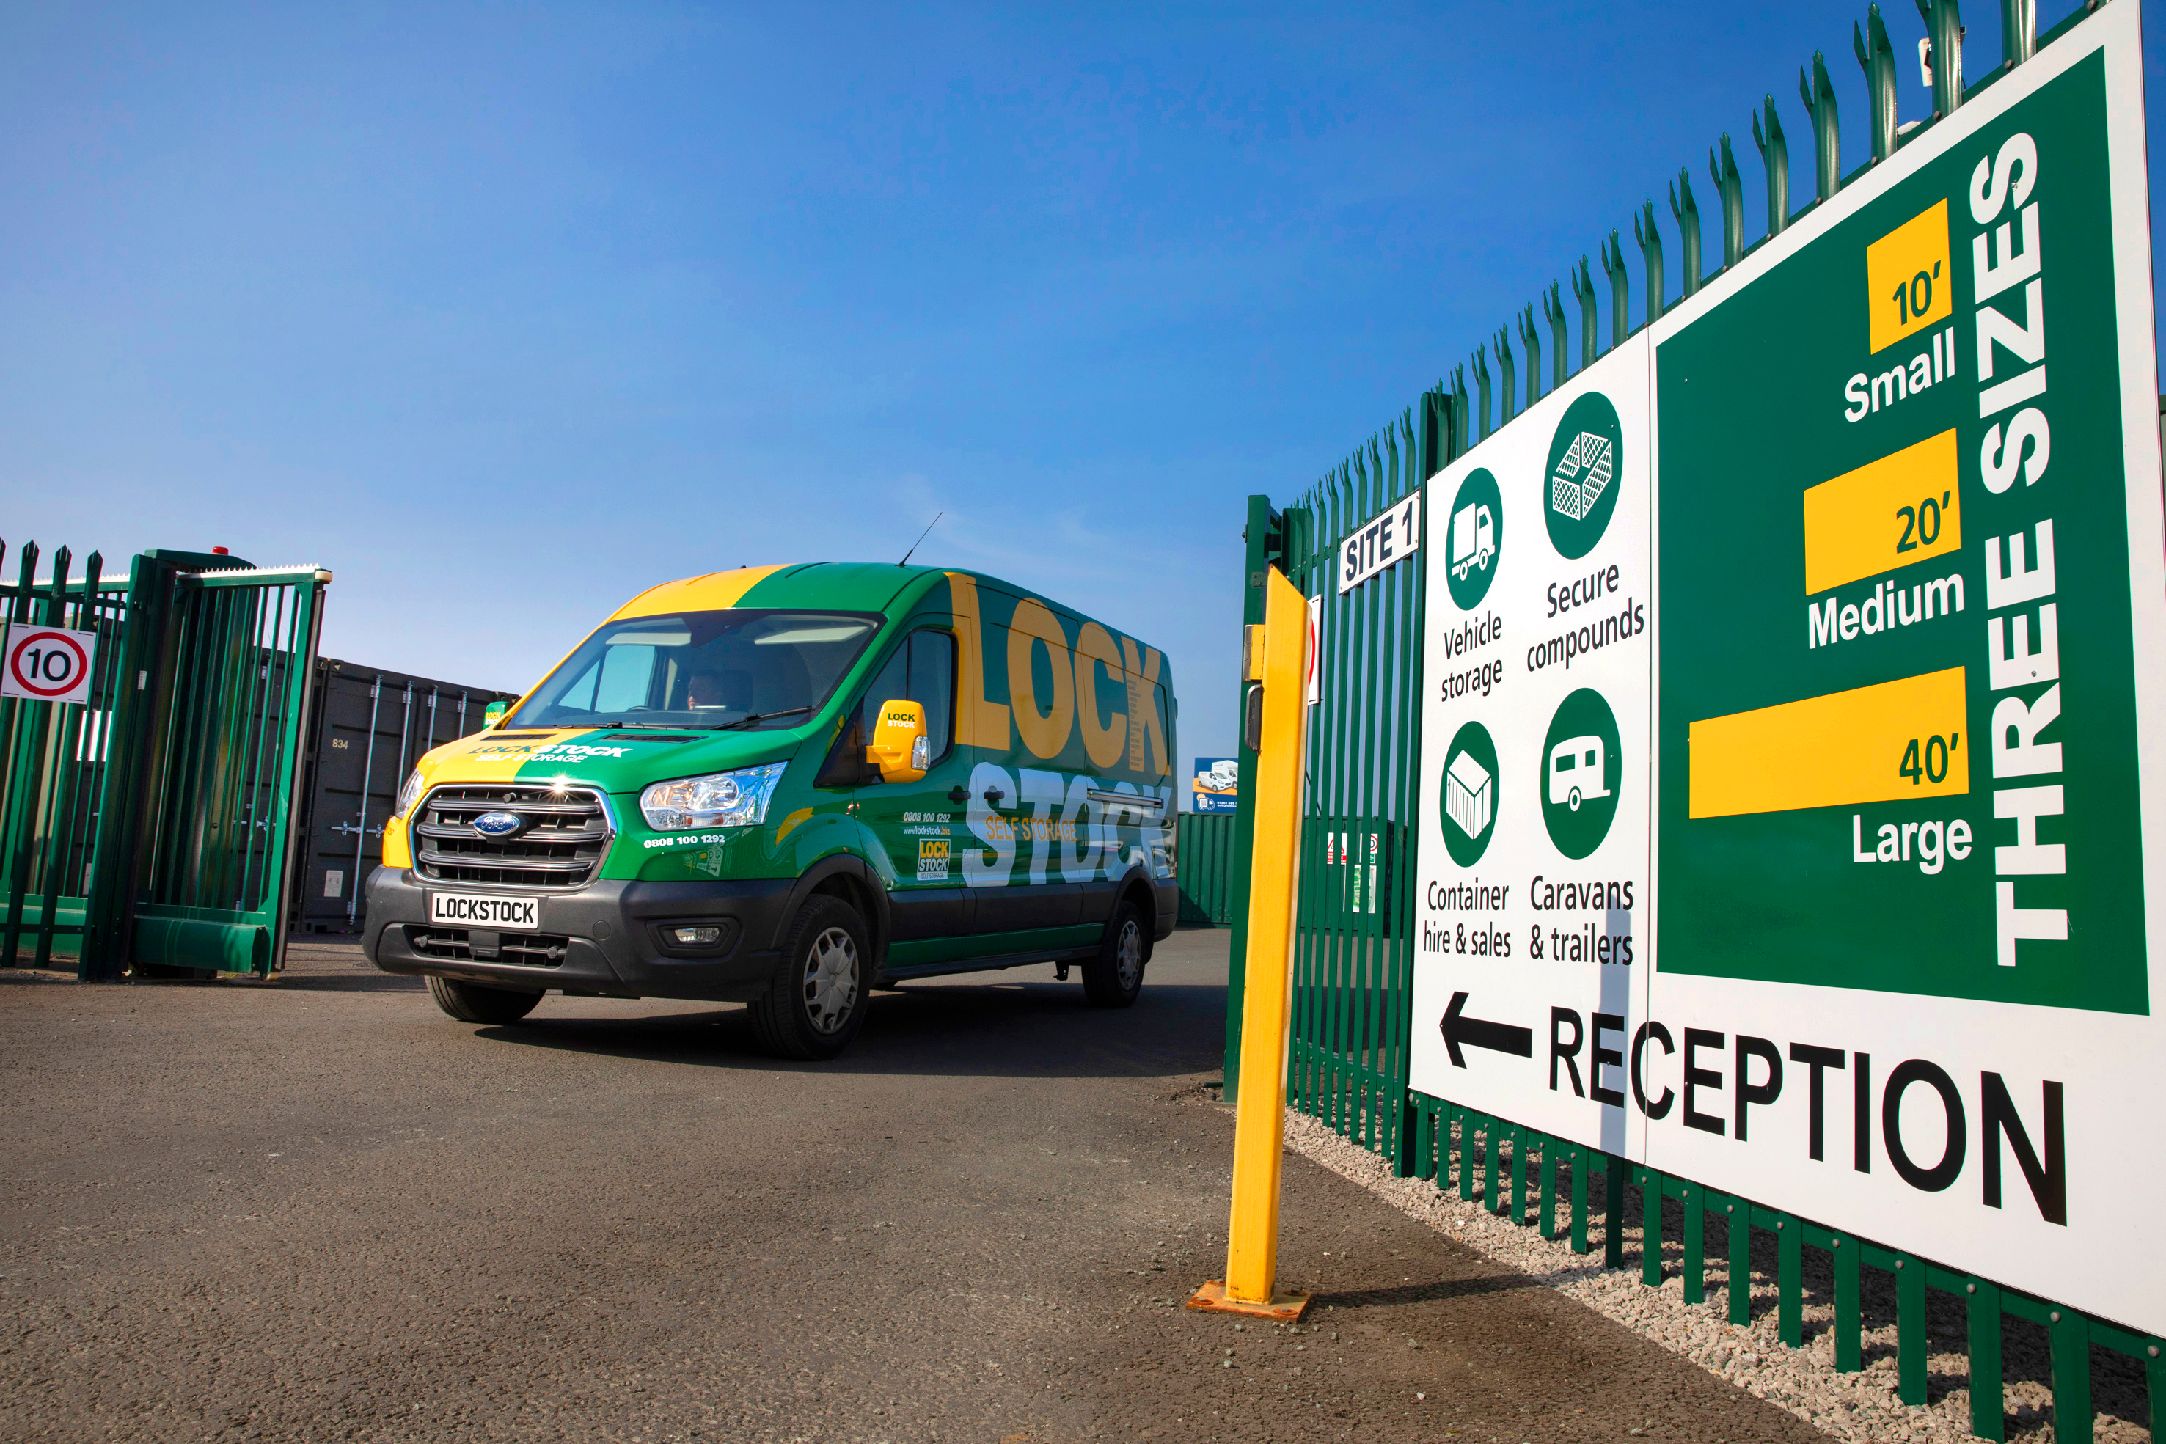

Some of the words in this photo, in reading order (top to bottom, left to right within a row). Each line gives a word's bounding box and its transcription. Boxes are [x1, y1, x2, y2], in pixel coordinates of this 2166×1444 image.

[1969, 132, 2050, 494] SIZES
[1844, 326, 1956, 423] Small
[1345, 513, 1394, 582] SITE
[1401, 500, 1413, 547] 1
[1547, 564, 1619, 618] Secure
[1808, 573, 1965, 650] Medium
[1444, 610, 1502, 660] Vehicle
[1527, 596, 1644, 672] compounds
[28, 648, 71, 682] 10
[943, 571, 1172, 777] LOCK
[1441, 659, 1502, 702] storage
[887, 713, 916, 723] LOCK
[887, 720, 916, 729] STOCK
[511, 754, 589, 763] STORAGE
[1984, 517, 2069, 967] THREE
[644, 837, 674, 849] 0808
[677, 835, 698, 845] 100
[701, 834, 726, 844] 1292
[961, 761, 1172, 888] STOCK
[985, 815, 1020, 840] SELF
[1023, 817, 1078, 842] STORAGE
[1853, 814, 1973, 875] Large
[919, 858, 949, 872] STOCK
[920, 841, 949, 858] LOCK
[435, 897, 534, 924] LOCKSTOCK
[1428, 877, 1509, 911] Container
[1530, 875, 1634, 911] Caravans
[1423, 919, 1450, 954] hire
[1455, 922, 1467, 954] &
[1471, 921, 1511, 958] sales
[1529, 923, 1544, 960] &
[1551, 922, 1633, 966] trailers
[1550, 1005, 2067, 1227] RECEPTION
